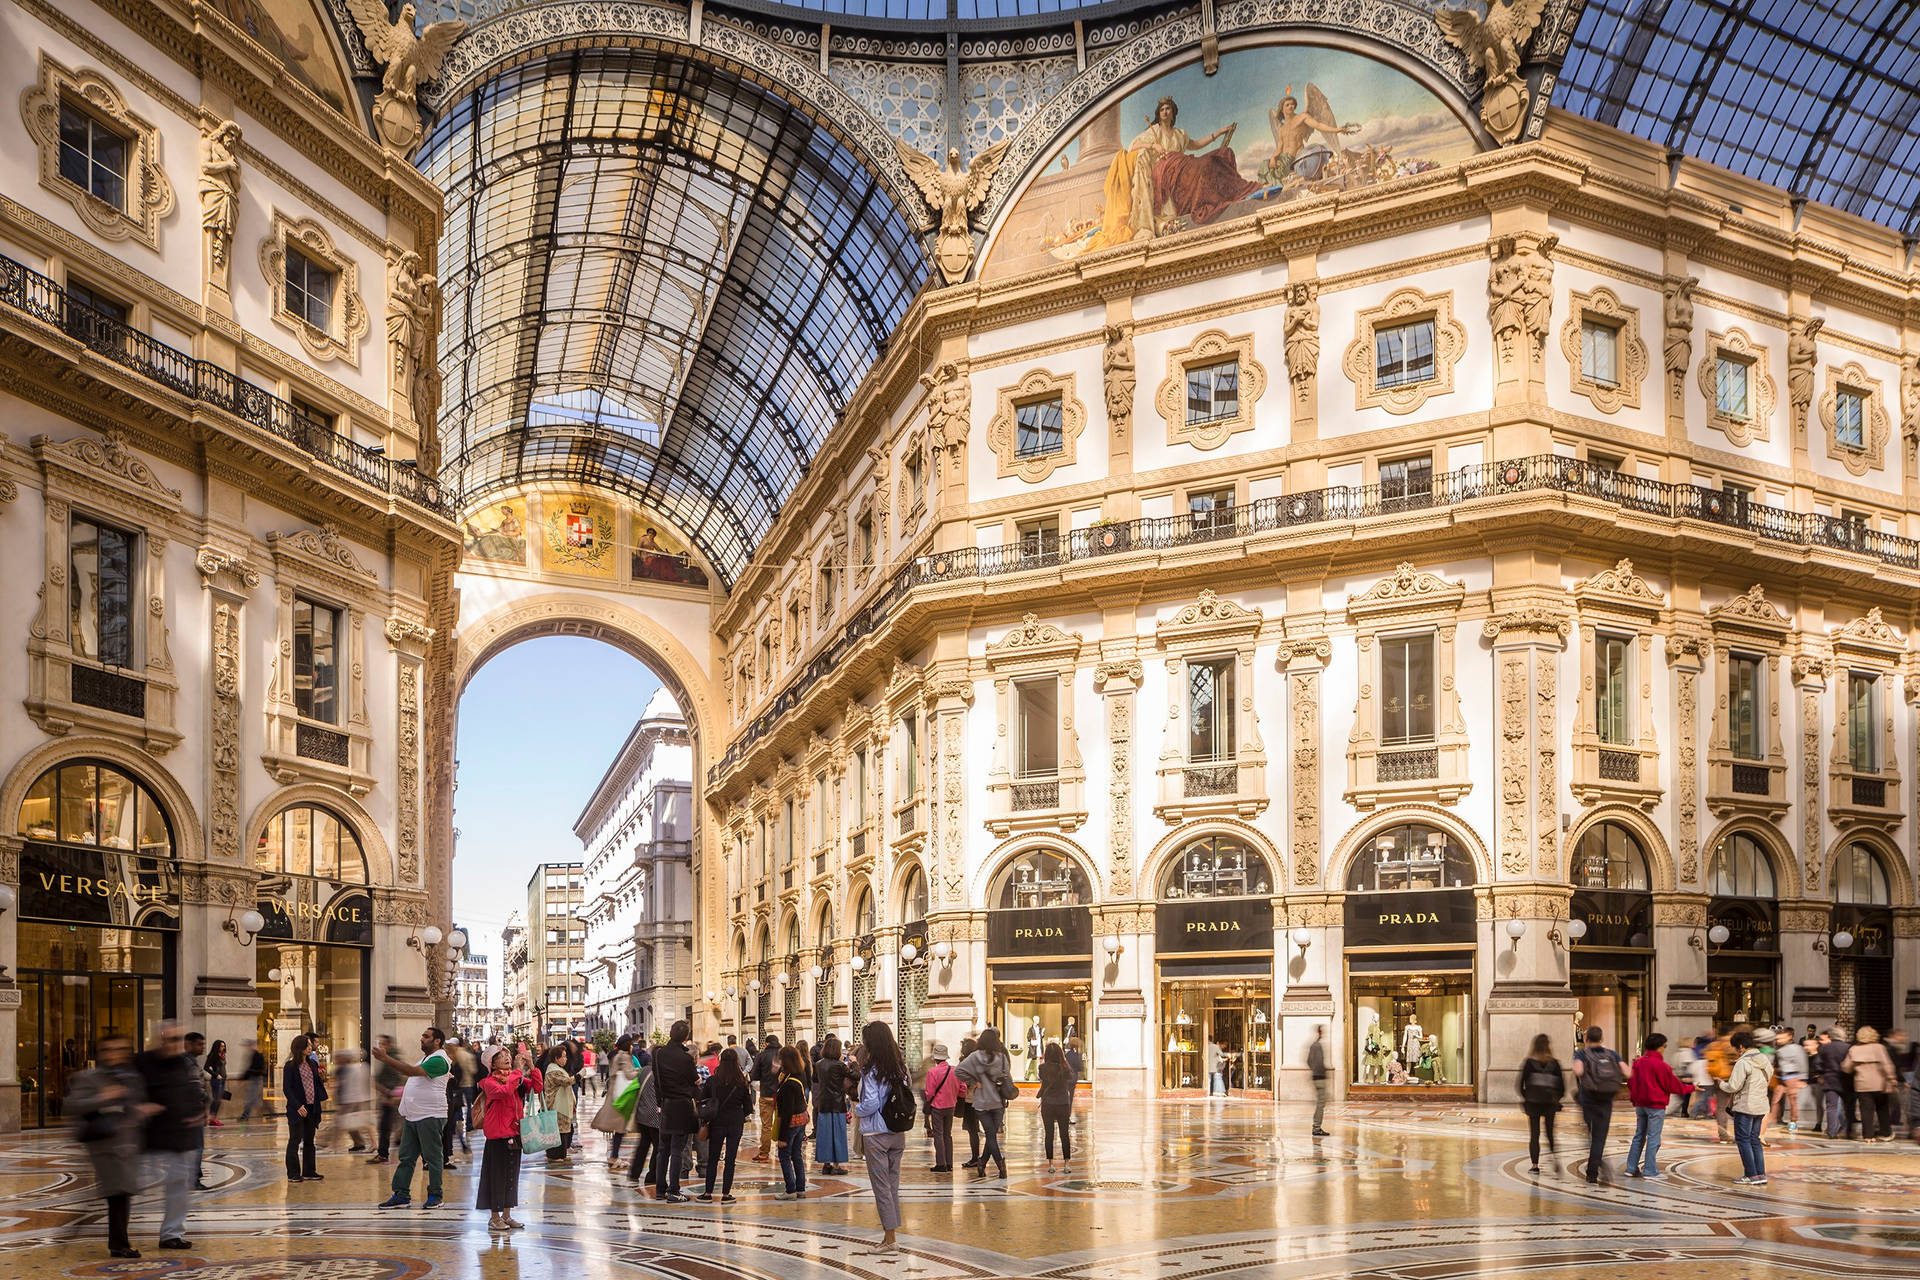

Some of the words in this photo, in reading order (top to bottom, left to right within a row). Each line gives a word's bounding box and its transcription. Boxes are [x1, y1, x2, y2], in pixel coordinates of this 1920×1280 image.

[39, 872, 162, 902] VERSACE
[271, 899, 361, 923] VERSACE
[1379, 912, 1440, 925] PRADA
[1588, 913, 1631, 926] PRADA
[1746, 916, 1772, 932] PRADA
[1015, 927, 1064, 938] PRADA
[1186, 921, 1241, 933] PRADA
